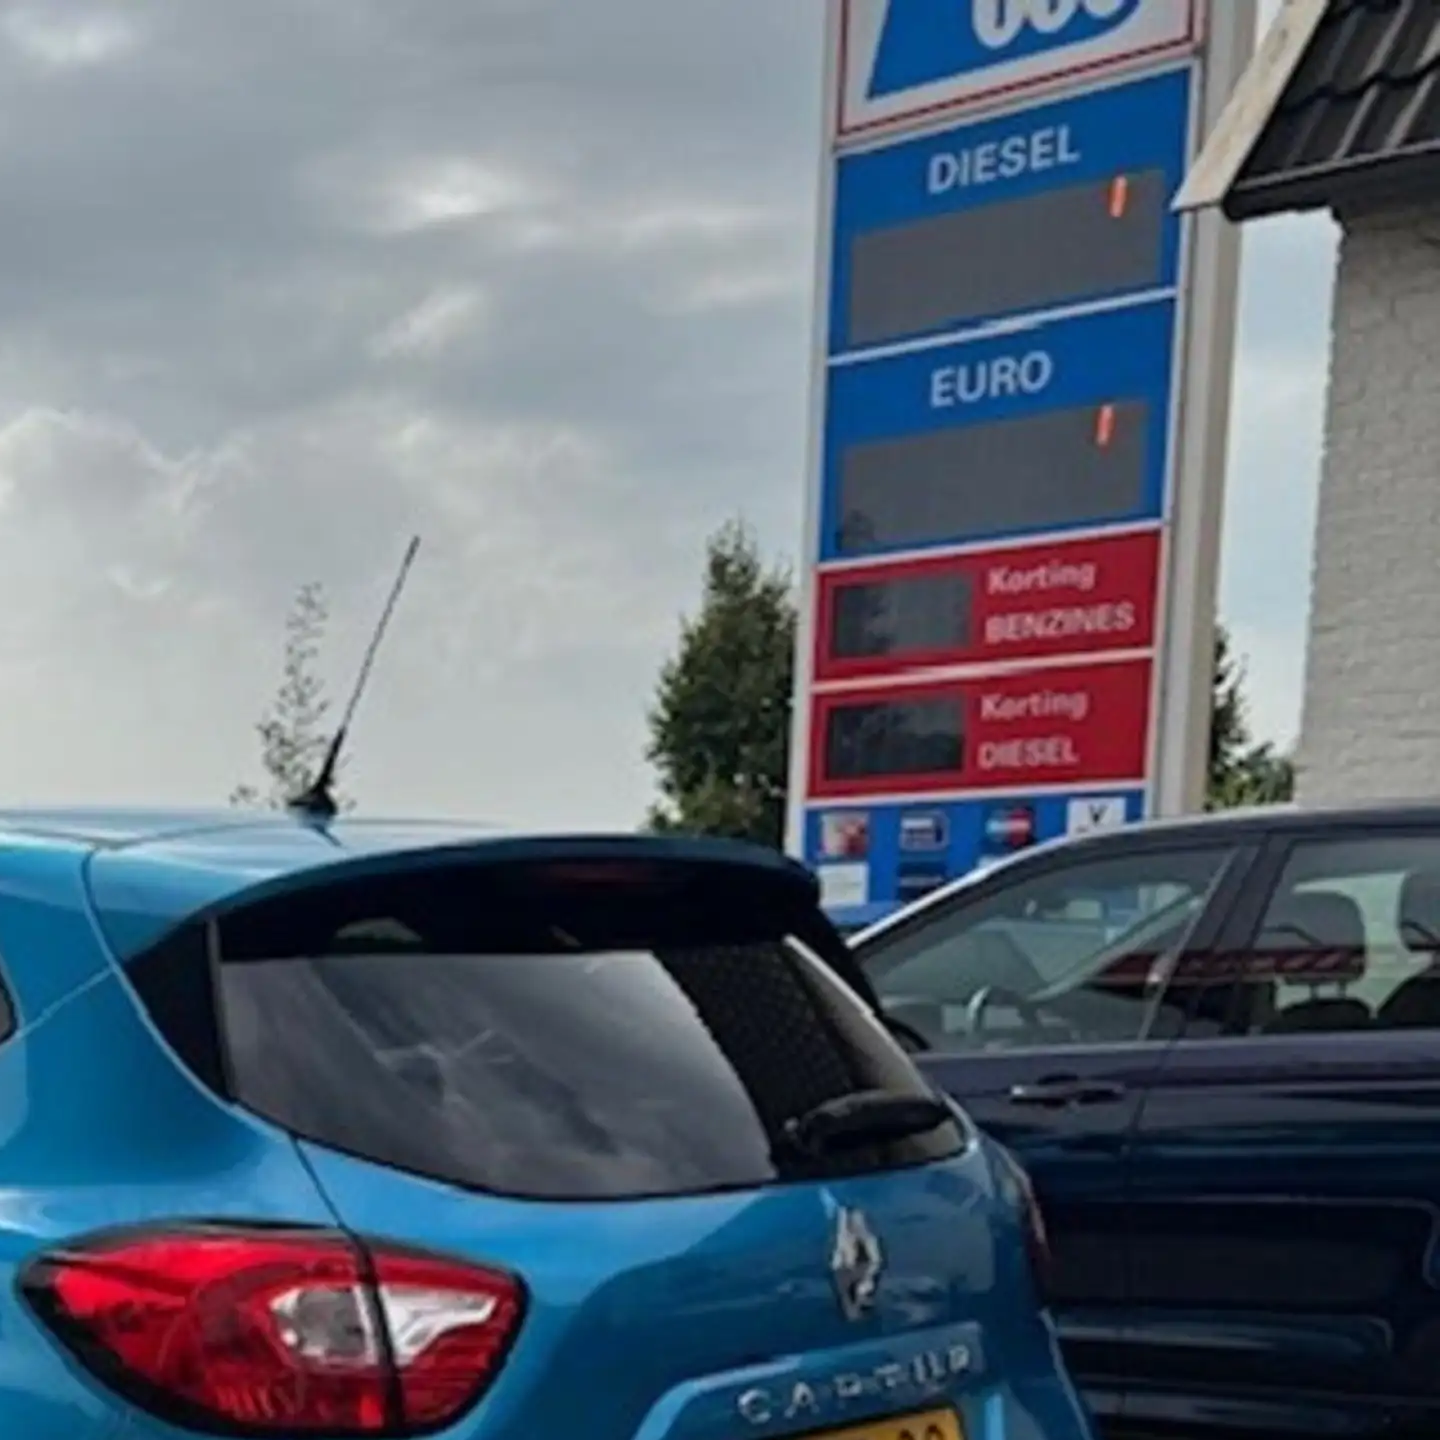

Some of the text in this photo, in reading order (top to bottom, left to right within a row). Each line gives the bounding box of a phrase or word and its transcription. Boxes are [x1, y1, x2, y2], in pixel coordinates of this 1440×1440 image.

[928, 126, 1080, 195] DIESEL
[929, 350, 1054, 408] EURO
[987, 561, 1096, 594] Korting
[984, 602, 1136, 645] BENZINES
[981, 691, 1087, 720] Korting
[978, 737, 1078, 770] DIESEL
